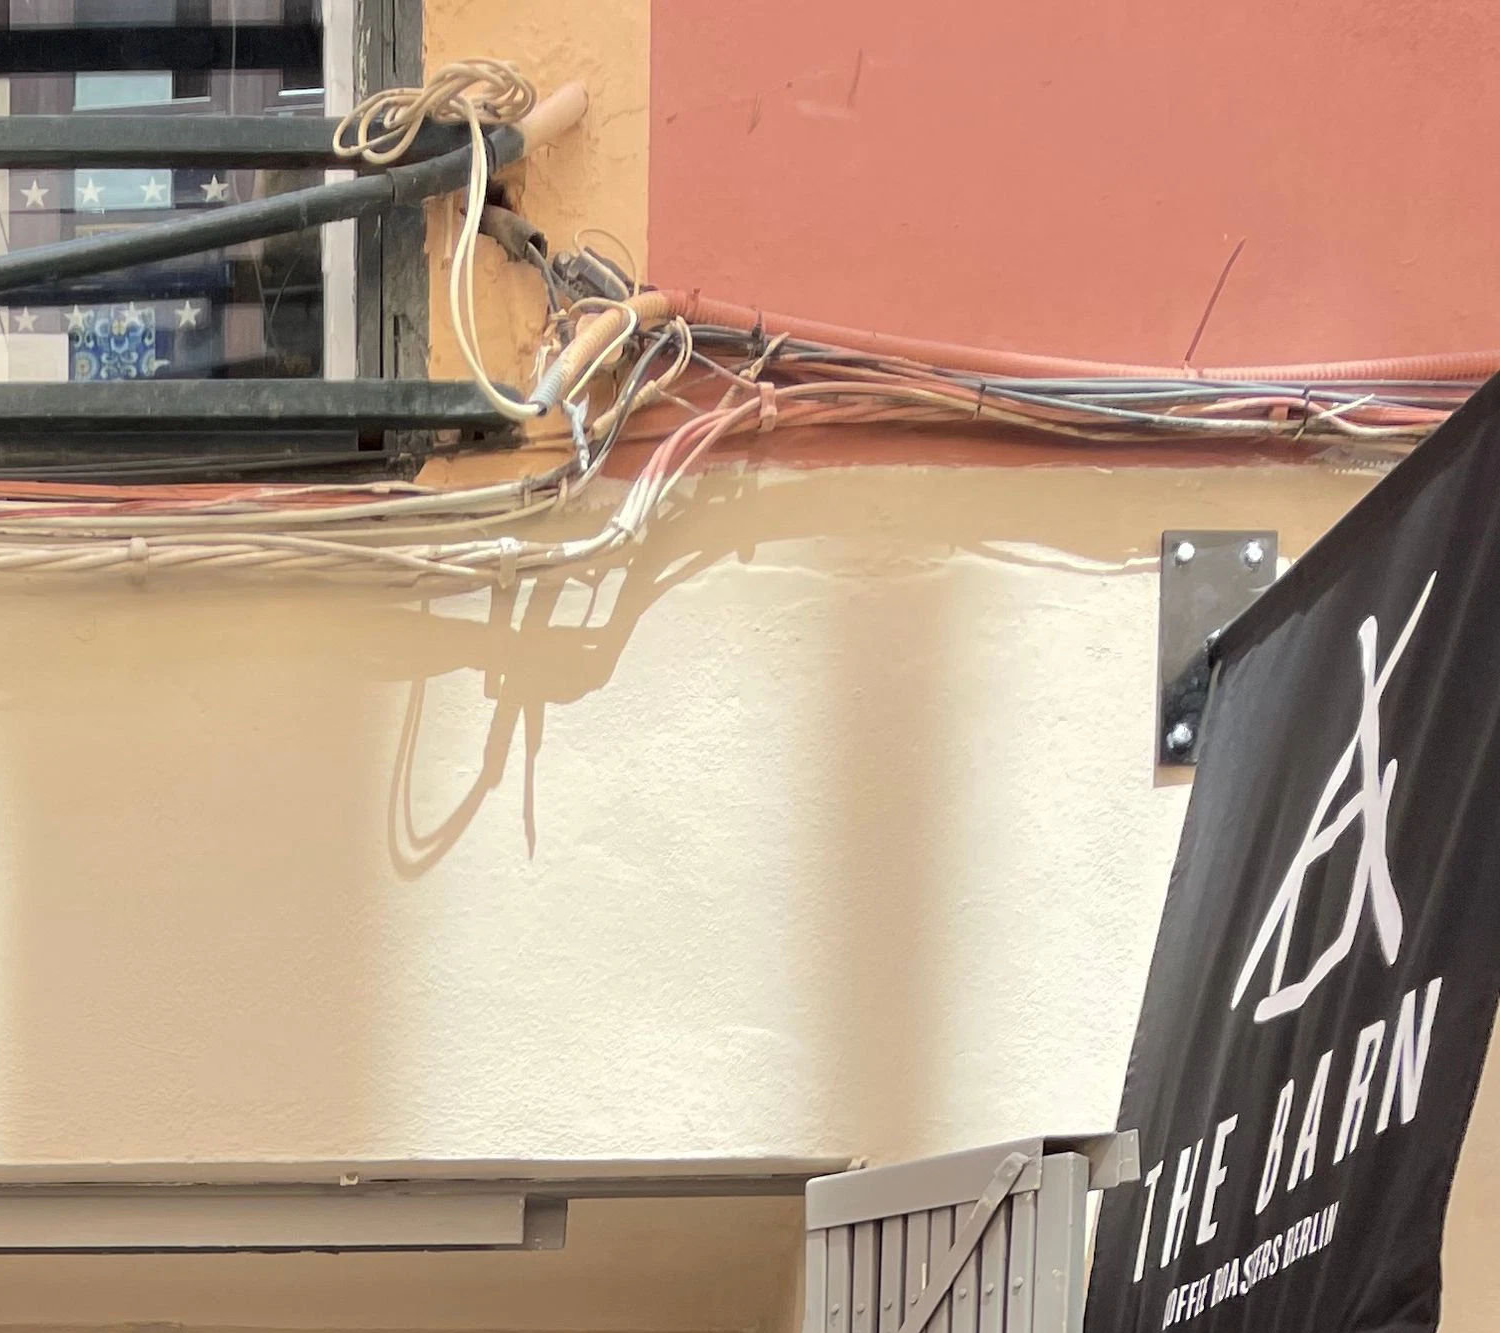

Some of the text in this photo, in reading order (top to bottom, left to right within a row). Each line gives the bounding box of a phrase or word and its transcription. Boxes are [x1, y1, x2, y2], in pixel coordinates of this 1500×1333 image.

[1133, 976, 1443, 1283] THE BARN
[1281, 1200, 1340, 1270] BERLIN
